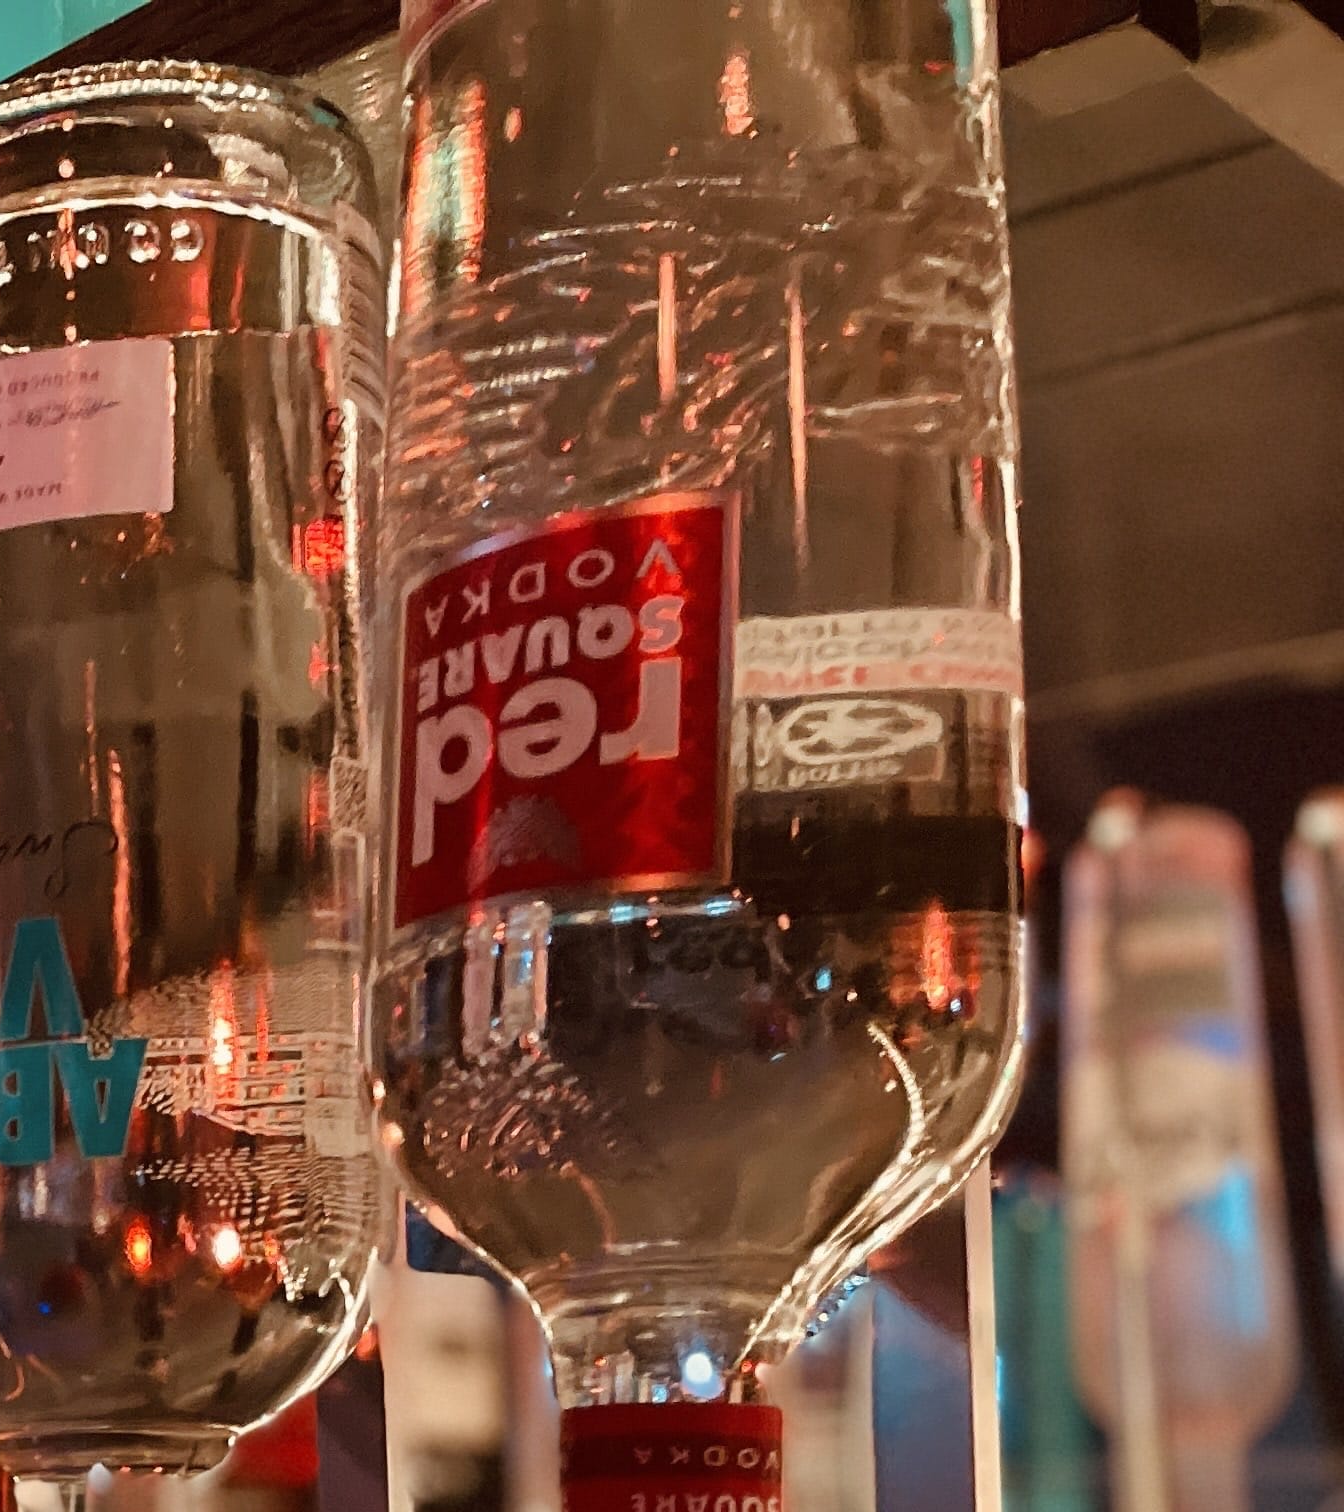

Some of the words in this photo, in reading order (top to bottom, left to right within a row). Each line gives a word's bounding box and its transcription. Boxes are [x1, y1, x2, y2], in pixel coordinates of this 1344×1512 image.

[423, 538, 683, 637] VODKA
[416, 594, 686, 712] SQUARE
[411, 654, 683, 867] red
[631, 1444, 780, 1474] VODKA
